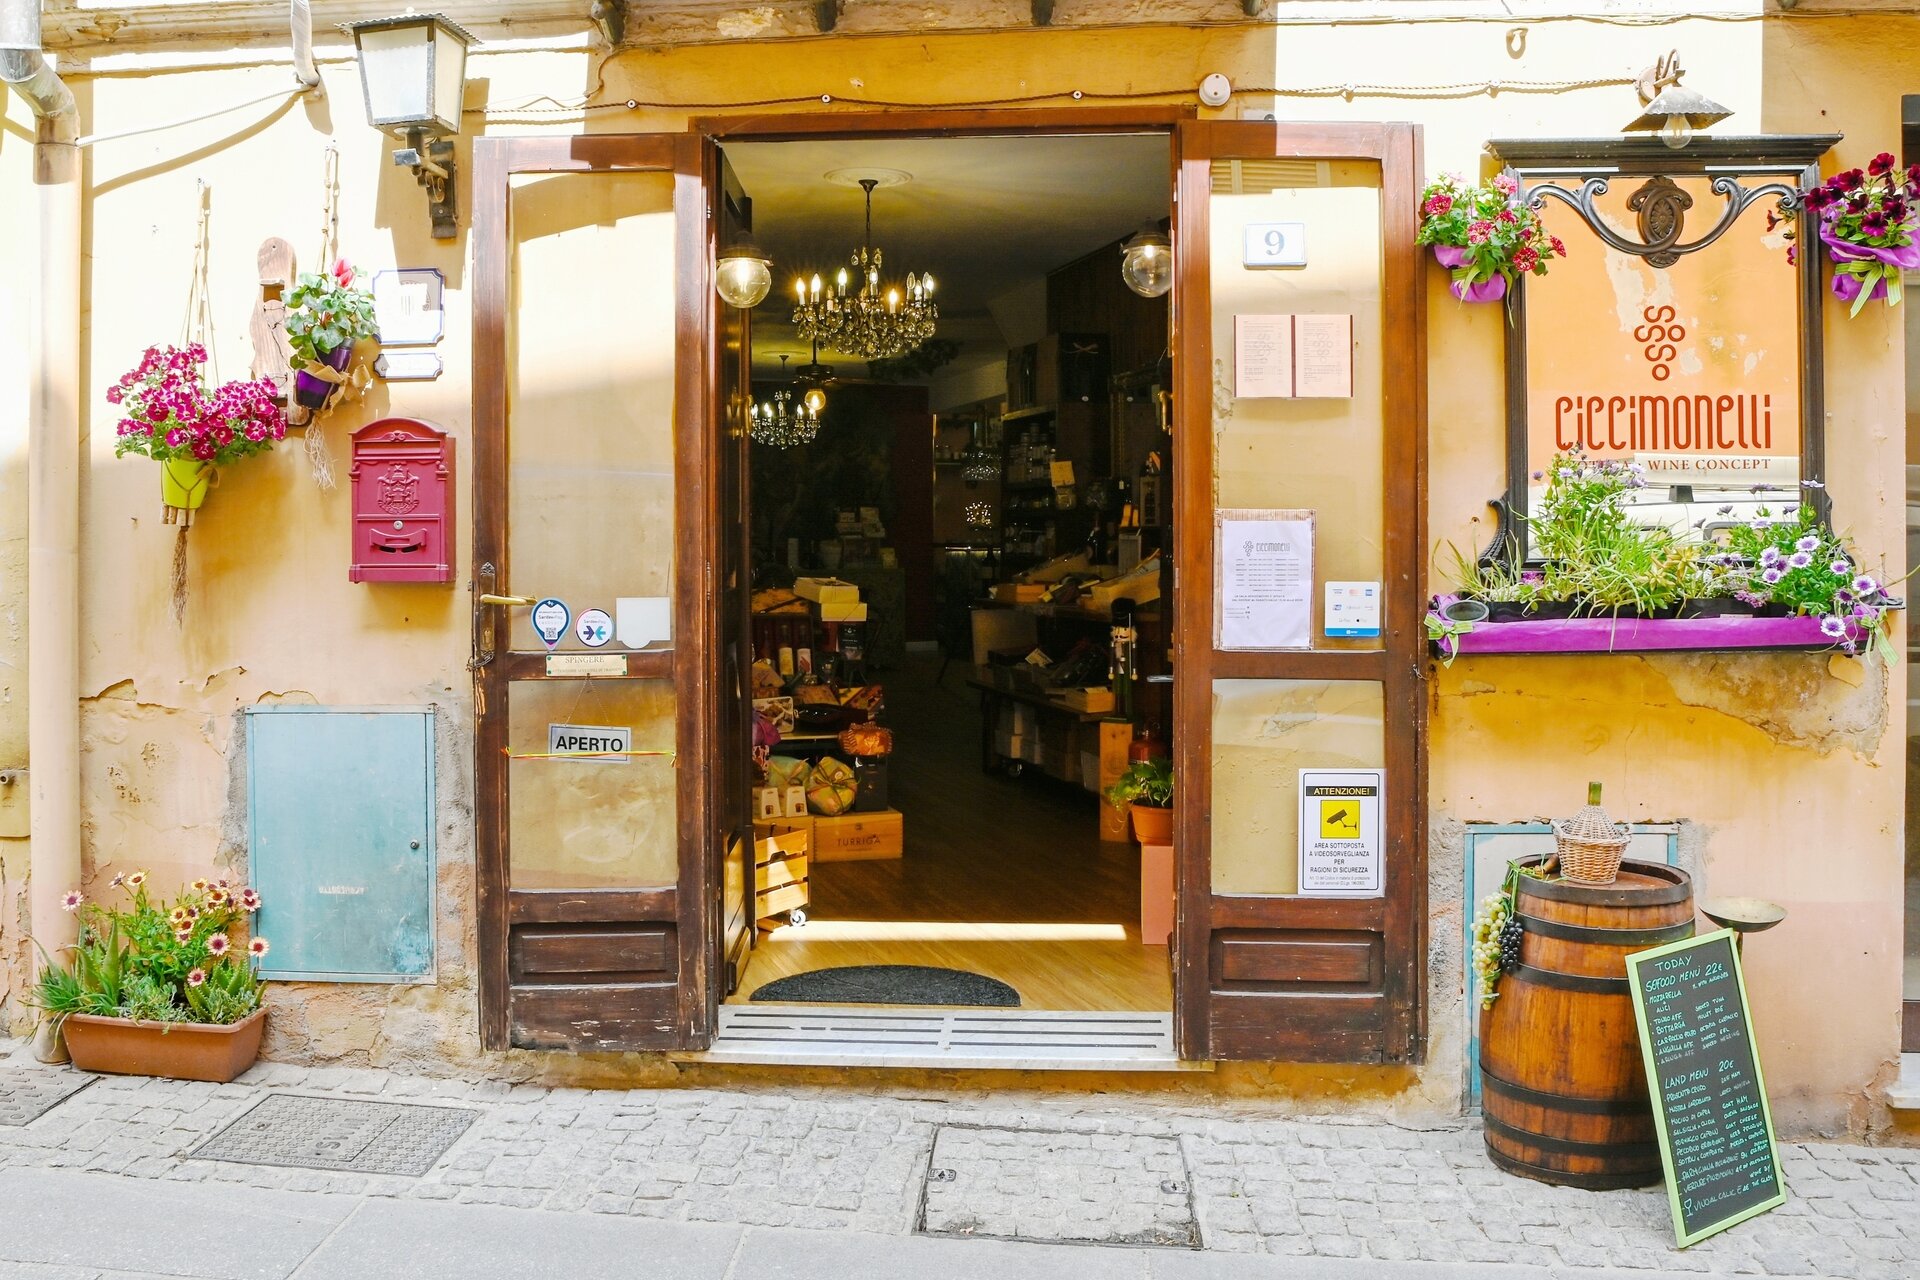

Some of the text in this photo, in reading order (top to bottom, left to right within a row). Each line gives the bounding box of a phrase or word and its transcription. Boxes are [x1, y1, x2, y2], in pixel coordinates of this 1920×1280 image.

[1264, 230, 1285, 256] 9
[1647, 458, 1771, 471] WINE CONCEPT
[565, 656, 605, 664] SPINGERE
[556, 736, 623, 752] APERTO
[1313, 787, 1370, 796] ATTENZIONE!
[1655, 956, 1691, 971] TODAY
[1705, 963, 1722, 976] 22€
[1649, 990, 1681, 1003] MOZZARELLA
[1653, 1016, 1670, 1024] TONNO
[1656, 1020, 1685, 1034] BOTTARGA
[1698, 1010, 1711, 1020] MULLET
[1665, 1060, 1733, 1089] LAND MENU 20€
[1722, 1101, 1734, 1109] GOAT
[1736, 1096, 1748, 1104] HAM
[1726, 1121, 1736, 1129] GOAT
[1740, 1114, 1757, 1124] CHEESE
[1694, 1198, 1711, 1211] VINO
